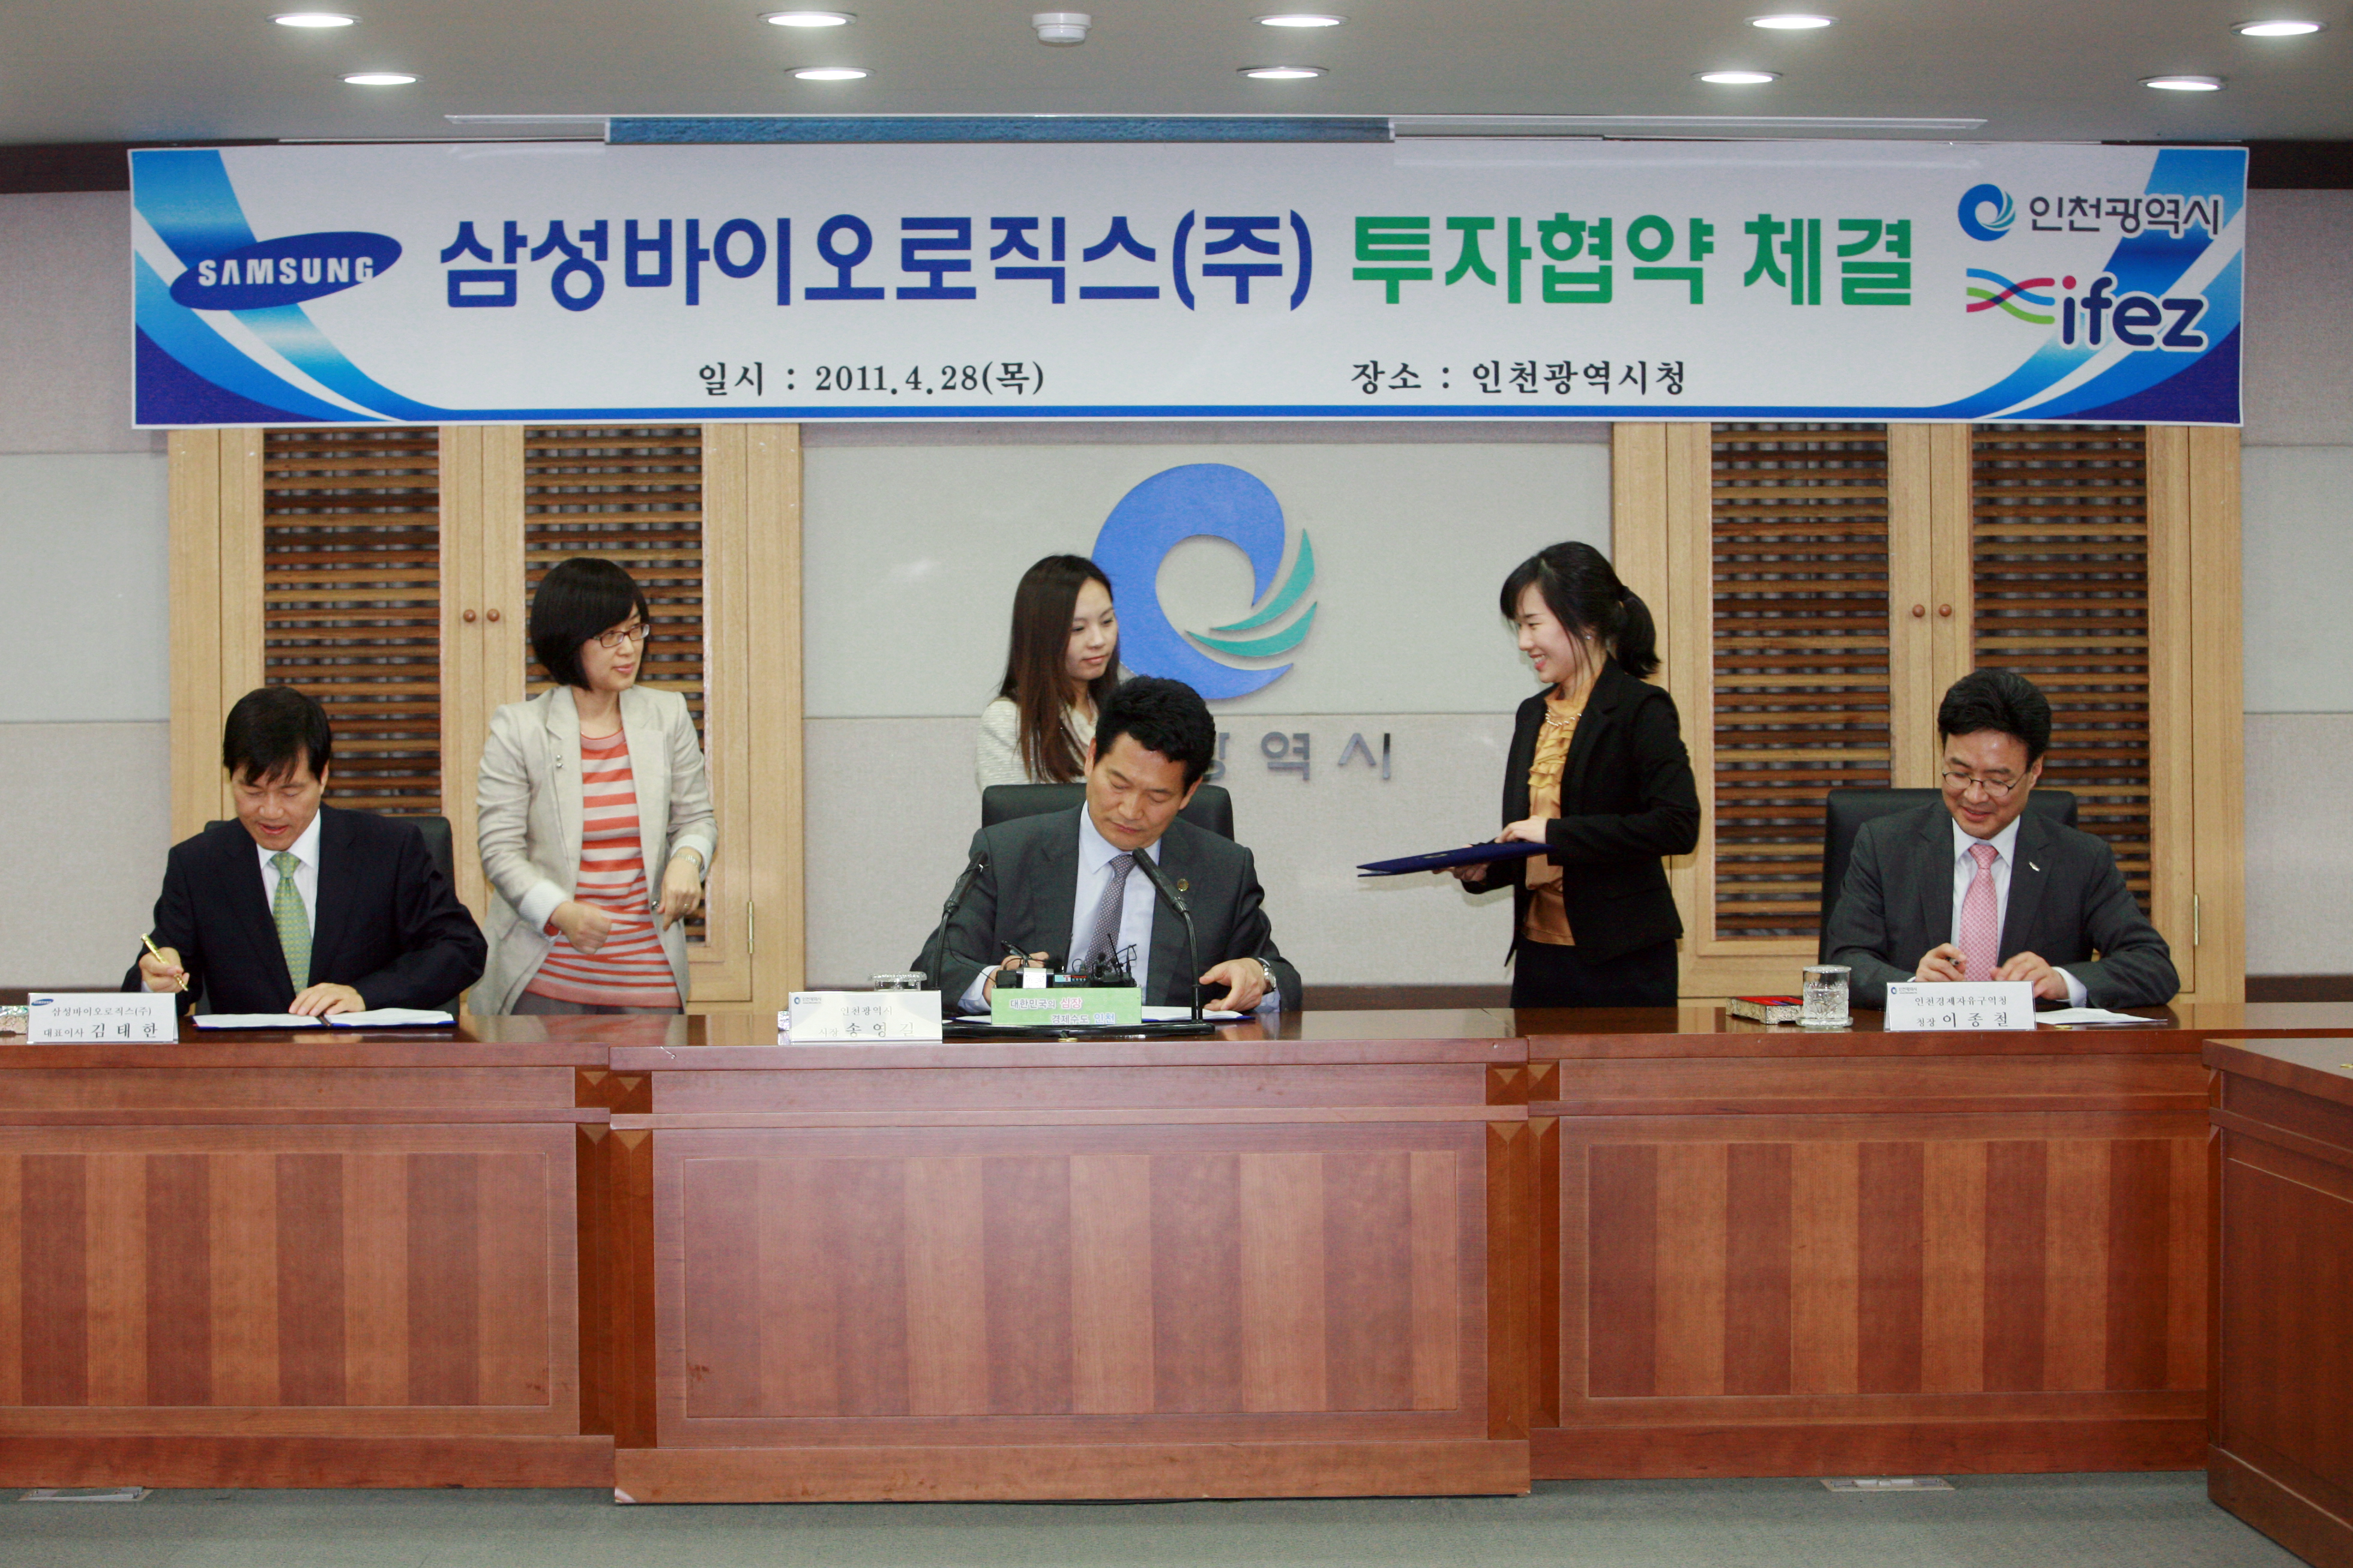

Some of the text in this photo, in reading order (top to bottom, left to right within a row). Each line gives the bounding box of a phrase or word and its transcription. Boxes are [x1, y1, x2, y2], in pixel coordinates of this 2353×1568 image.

[2029, 196, 2219, 235] 인천광역시
[198, 256, 374, 286] SAMSUNG
[440, 209, 1912, 311] 삼성바이오로직스(주) 투자협약 체결
[2061, 275, 2204, 347] ifez
[699, 362, 764, 396] 일시
[815, 361, 1044, 396] 2011.4.28(목)
[1351, 360, 1422, 395] 장소
[1472, 360, 1685, 395] 인천광역시청
[840, 1006, 893, 1016] 인천광역시
[1010, 998, 1082, 1009] 대한민국의 심장
[1052, 1013, 1115, 1024] 경제수도 인천
[44, 1027, 85, 1038] 대표이사
